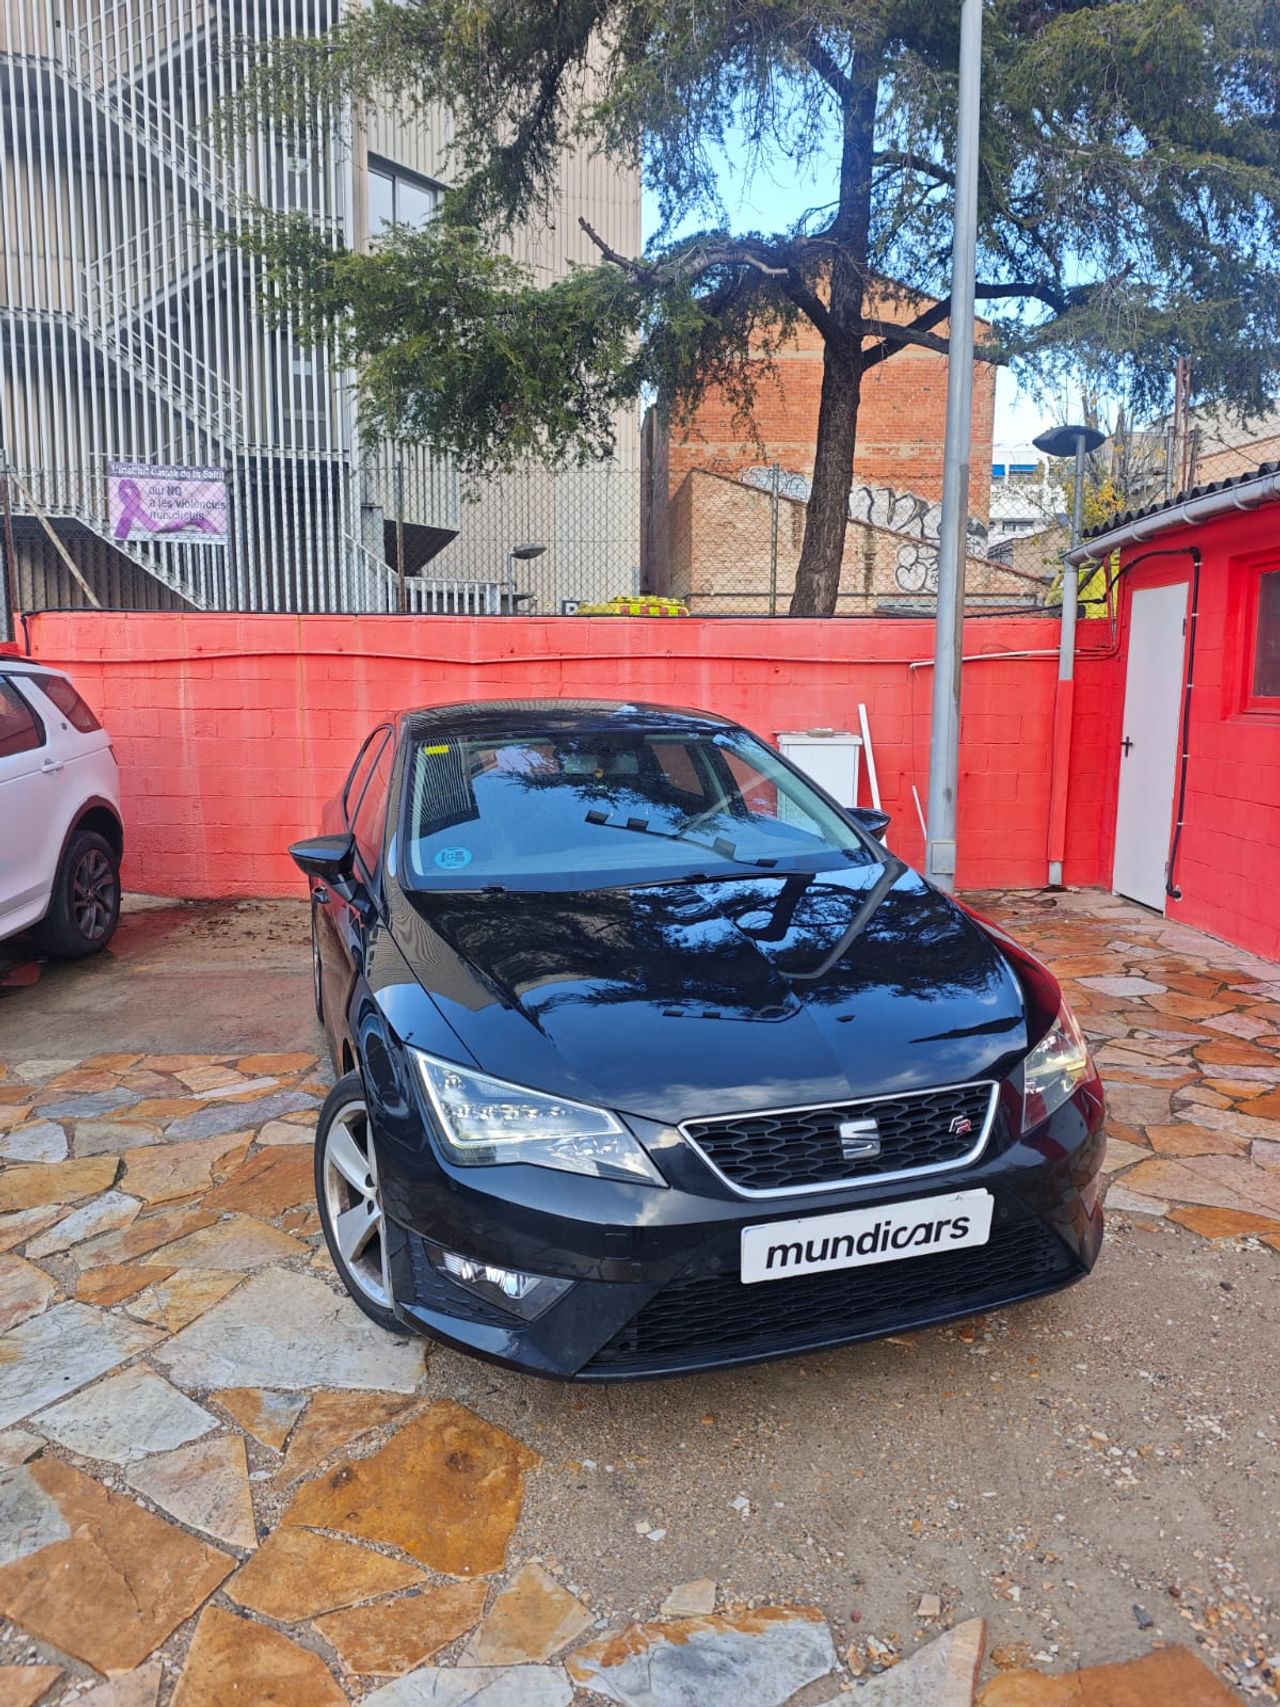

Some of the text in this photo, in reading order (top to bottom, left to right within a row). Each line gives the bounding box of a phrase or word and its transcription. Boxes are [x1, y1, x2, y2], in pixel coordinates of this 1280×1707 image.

[167, 486, 182, 496] NO
[149, 499, 155, 507] a
[158, 499, 173, 508] les
[766, 1216, 970, 1269] mundicars
